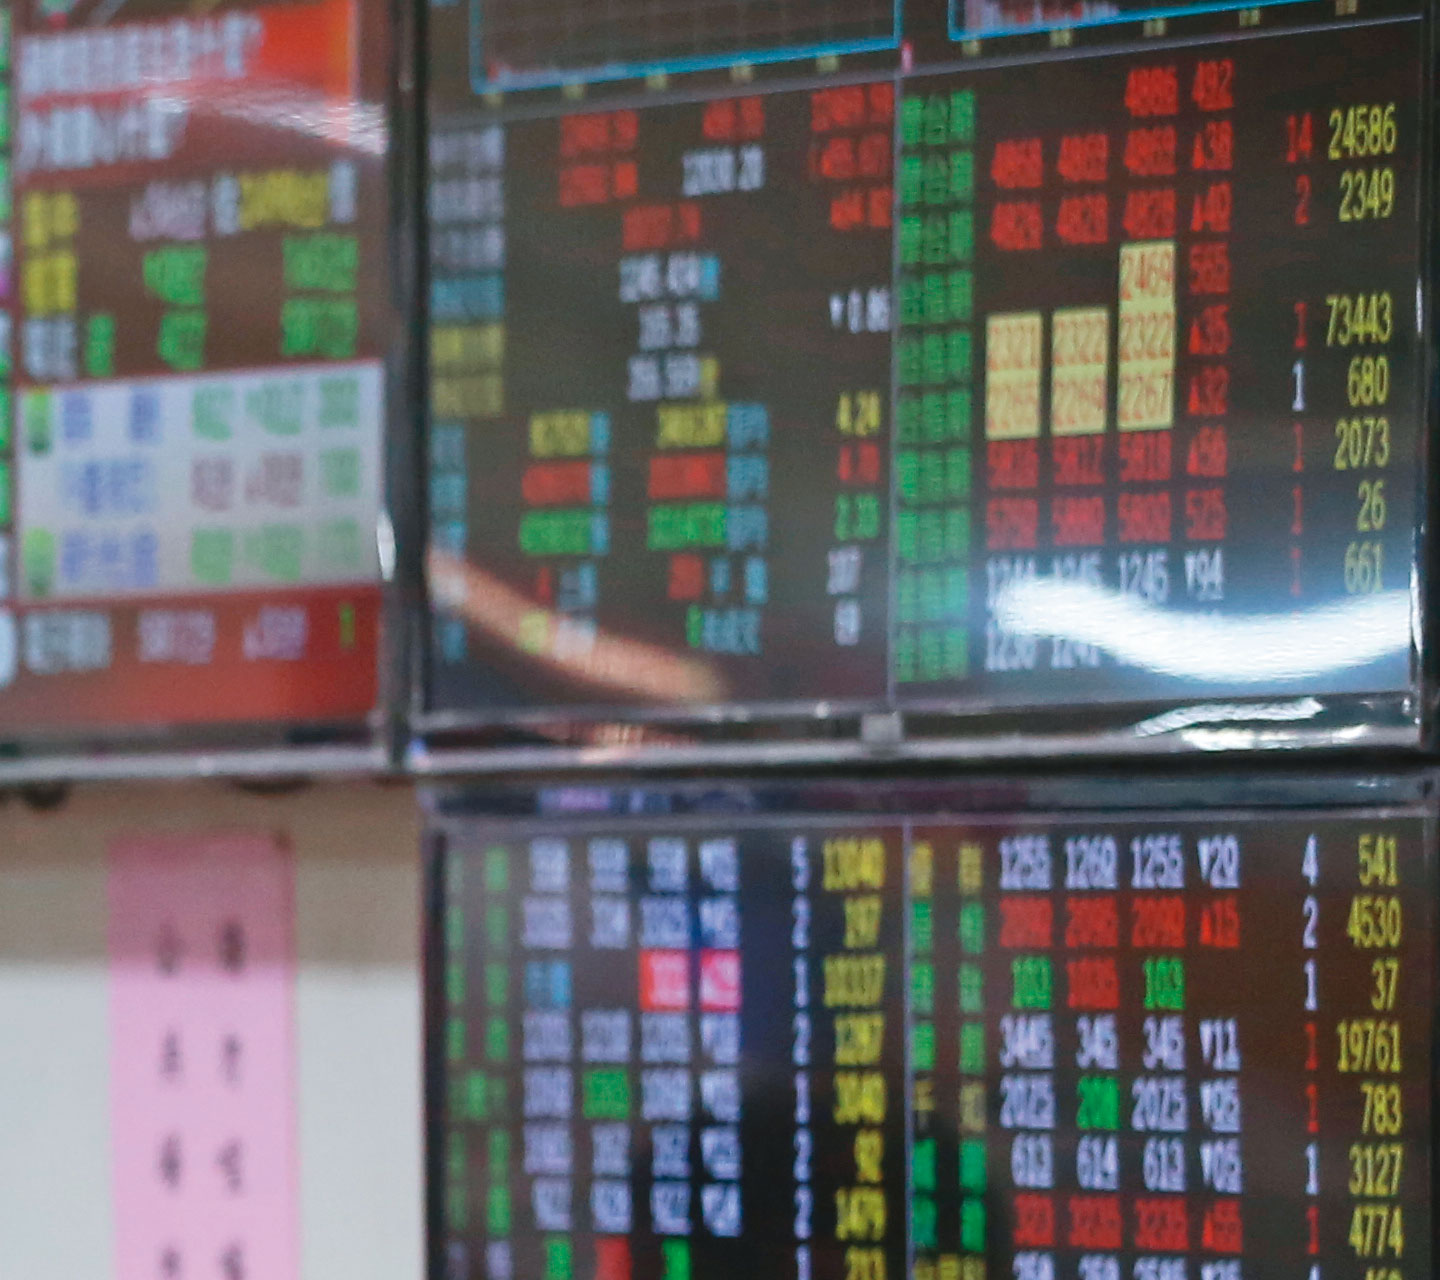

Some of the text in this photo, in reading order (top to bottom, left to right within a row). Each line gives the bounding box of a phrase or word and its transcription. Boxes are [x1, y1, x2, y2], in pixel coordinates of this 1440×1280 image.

[1286, 112, 1313, 163] 14
[1328, 102, 1396, 160] 24586
[1295, 175, 1311, 225] 2
[1339, 168, 1394, 222] 2349
[1121, 313, 1173, 360] 2322
[1294, 302, 1307, 349] 1
[1326, 292, 1392, 346] 73443
[1292, 360, 1305, 412] 1
[1348, 355, 1390, 407] 680
[1293, 423, 1304, 472] 1
[1333, 417, 1390, 471] 2073
[1291, 486, 1303, 536] 1
[1358, 479, 1387, 532] 26
[1118, 548, 1169, 605] 1245
[1344, 540, 1383, 596] 661
[1131, 834, 1185, 889] 1255
[1209, 834, 1240, 889] 20
[1302, 833, 1318, 887] 4
[1359, 833, 1398, 887] 541
[1303, 895, 1318, 949] 2
[1346, 895, 1402, 948] 4530
[1304, 957, 1399, 1011] 1 37
[1076, 1014, 1119, 1069] 345
[1143, 1015, 1186, 1070] 345
[1213, 1017, 1240, 1071] 11
[1305, 1022, 1317, 1071] 1
[1337, 1019, 1401, 1073] 19761
[1306, 1083, 1319, 1132] 1
[1361, 1081, 1402, 1135] 783
[1076, 1133, 1120, 1190] 614
[1143, 1136, 1186, 1192] 613
[1305, 1142, 1319, 1195] 1
[1349, 1141, 1404, 1197] 3127
[1306, 1203, 1404, 1258] 1 4774
